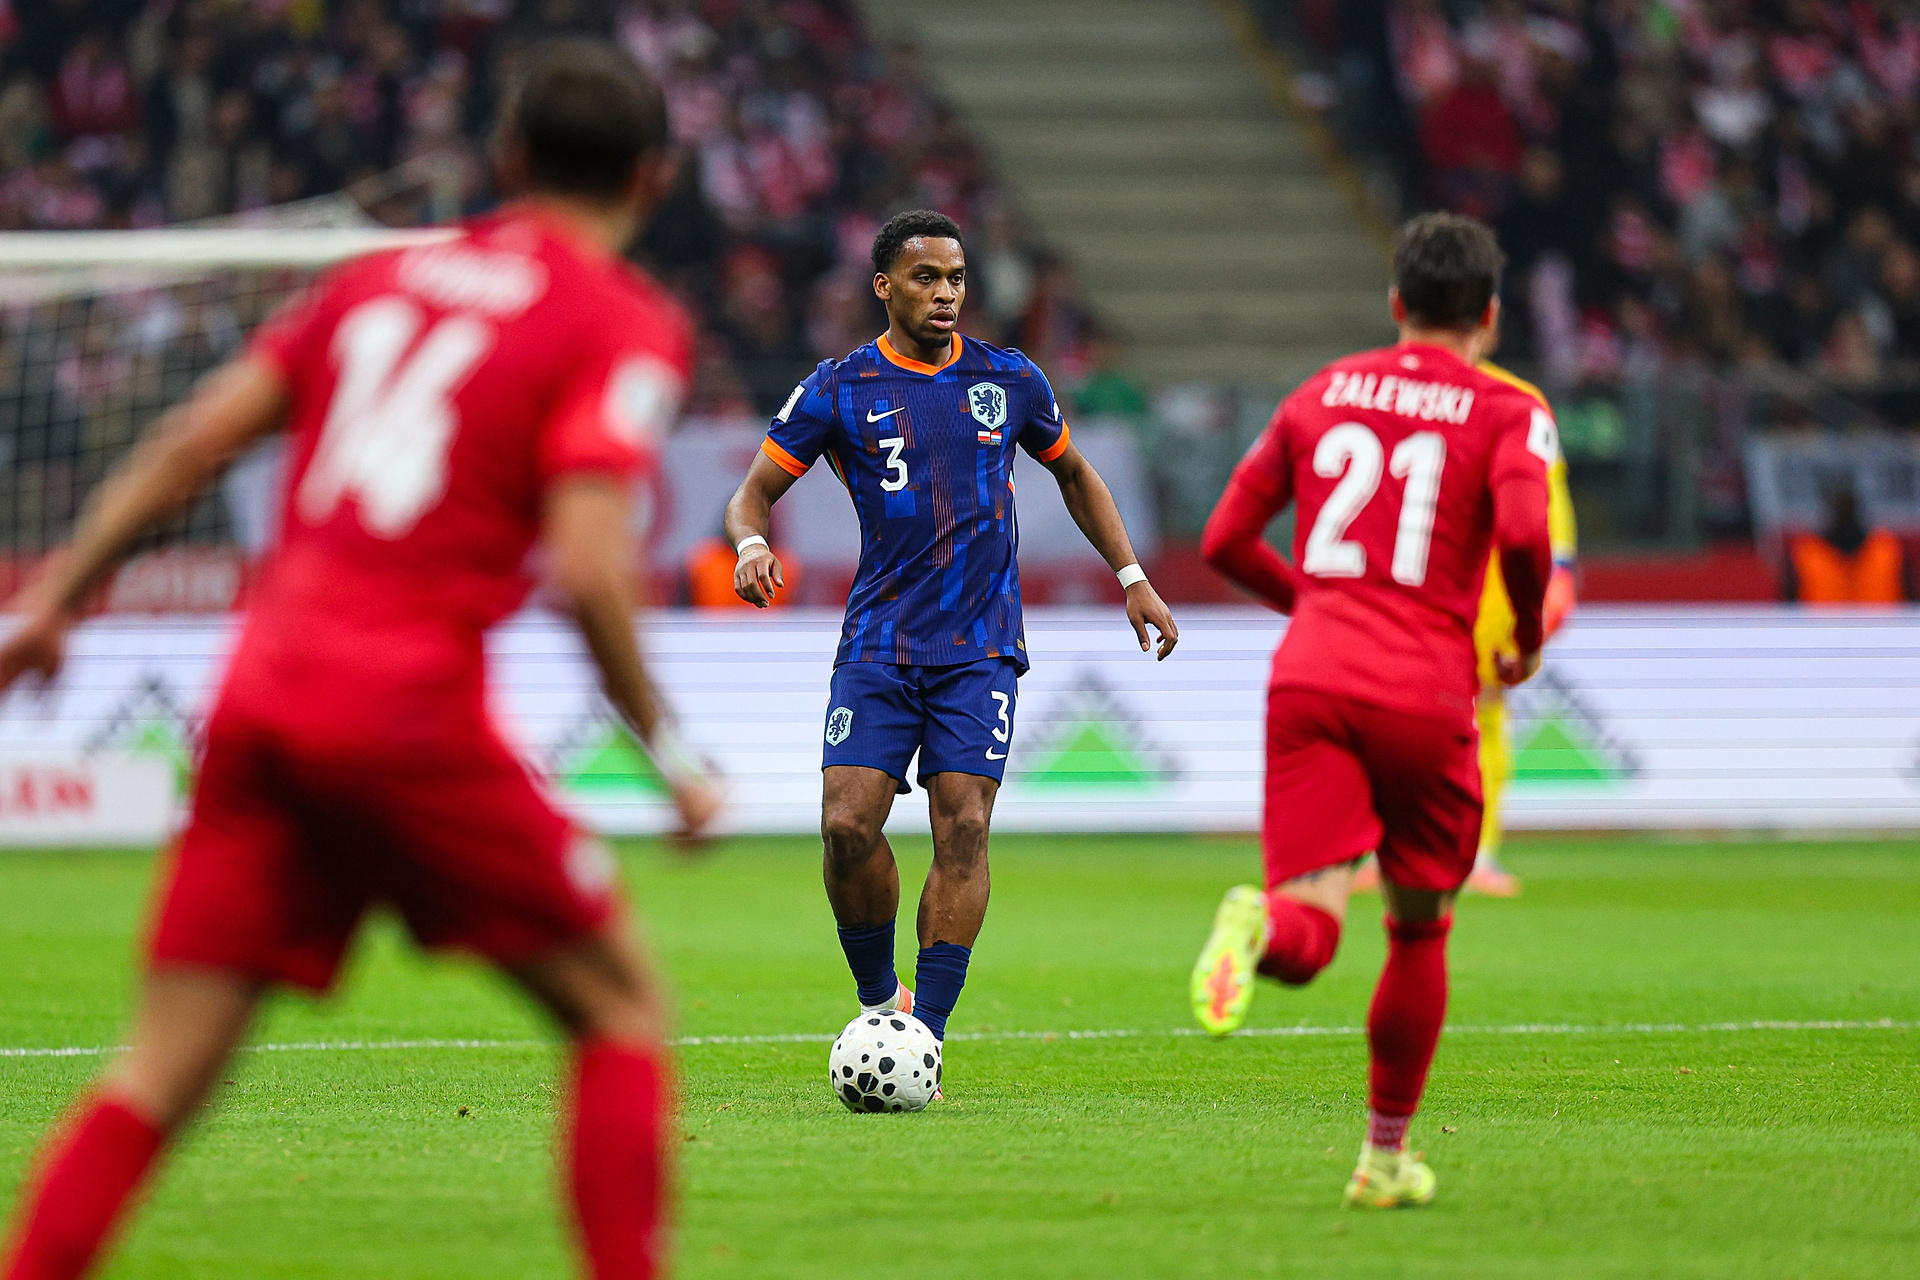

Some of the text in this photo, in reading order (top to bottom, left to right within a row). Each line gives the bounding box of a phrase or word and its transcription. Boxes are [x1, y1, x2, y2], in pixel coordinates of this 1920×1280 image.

[1321, 371, 1475, 425] ZALEWSKI
[878, 436, 909, 492] 3
[1302, 421, 1447, 588] 21
[990, 690, 1010, 744] 3
